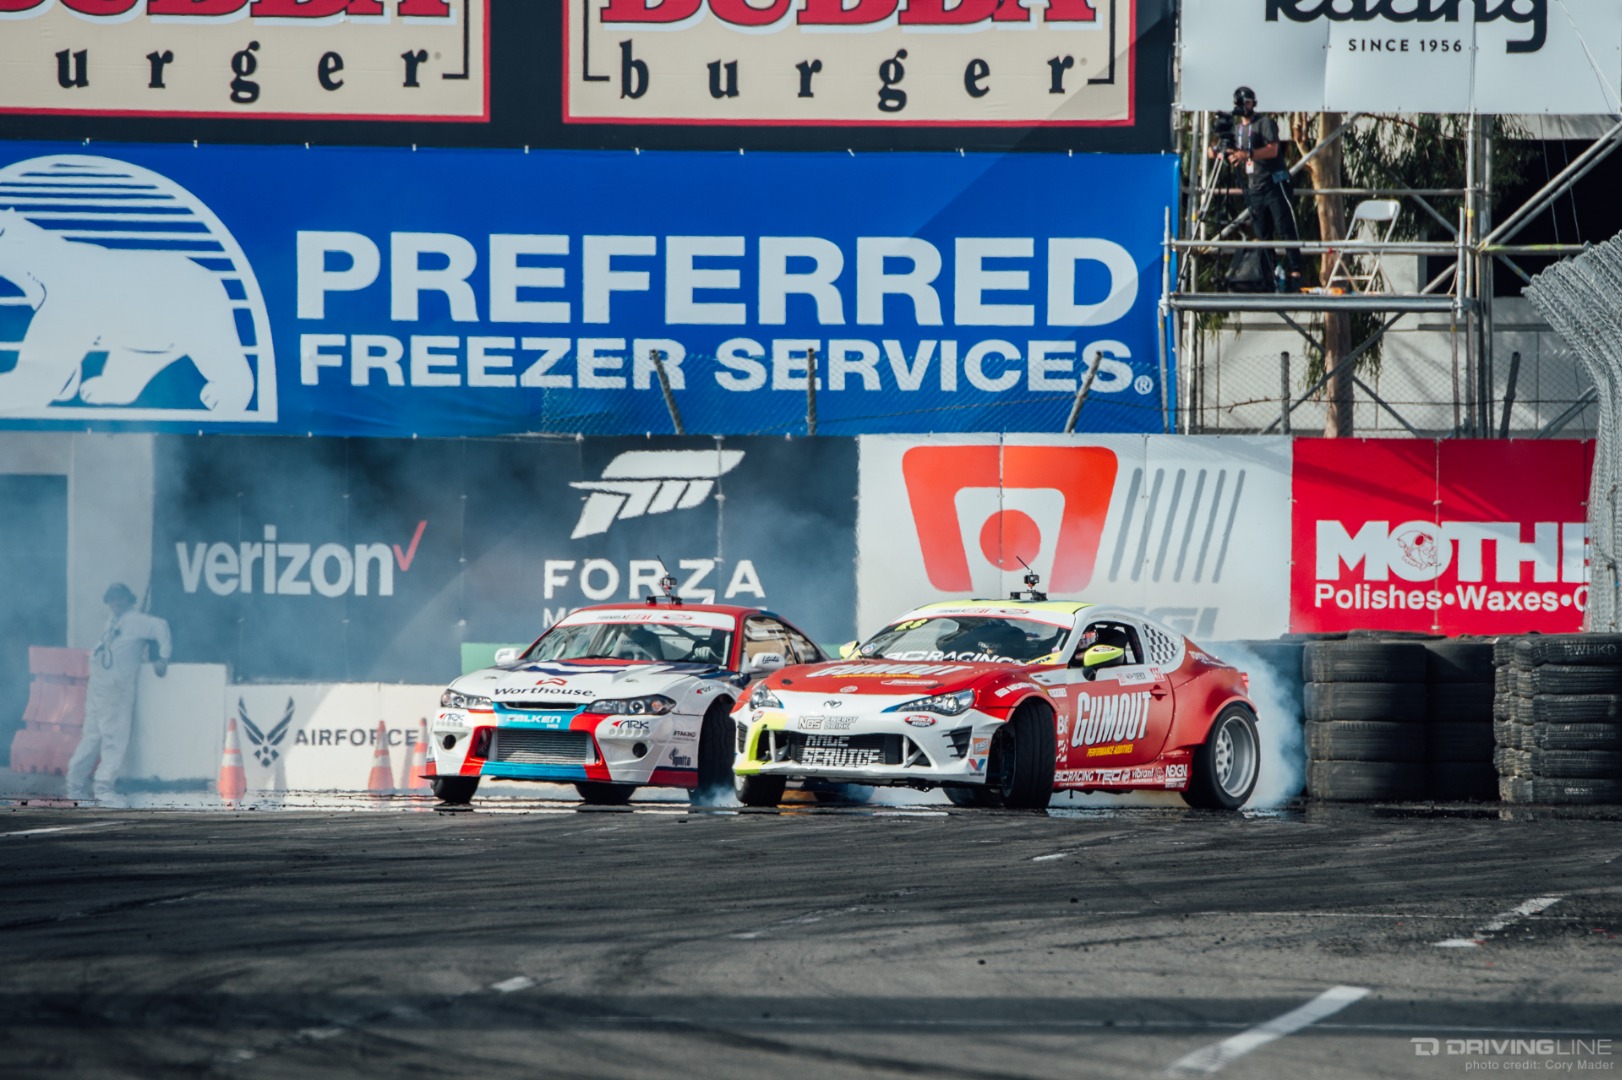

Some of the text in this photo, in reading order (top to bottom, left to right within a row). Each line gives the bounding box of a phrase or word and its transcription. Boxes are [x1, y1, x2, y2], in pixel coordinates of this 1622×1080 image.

[1348, 39, 1462, 52] SINCE 1956
[619, 38, 1075, 113] burger
[297, 230, 1140, 327] PREFERRED
[300, 333, 687, 391] FREEZER
[176, 524, 394, 598] verizon
[544, 558, 767, 601] FORZA
[797, 715, 825, 730] NOS
[1071, 691, 1152, 748] GUMOUT
